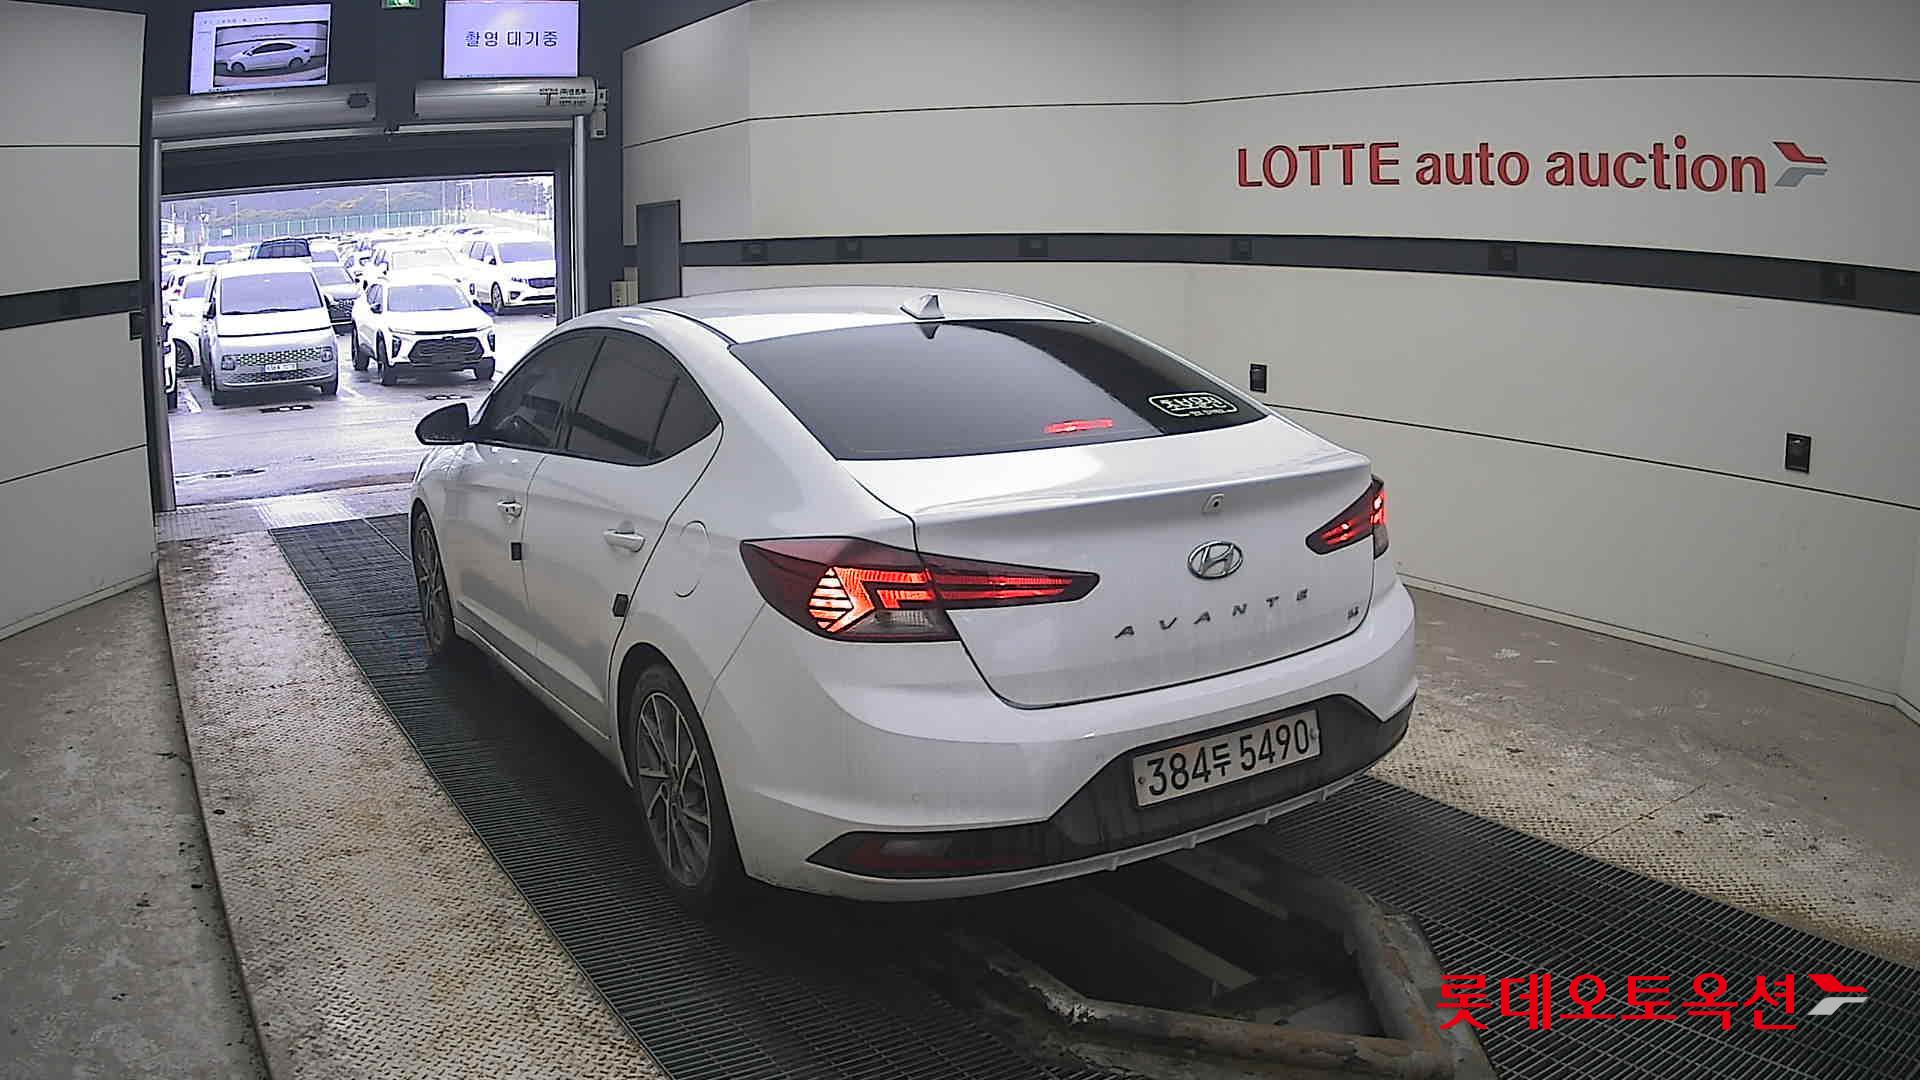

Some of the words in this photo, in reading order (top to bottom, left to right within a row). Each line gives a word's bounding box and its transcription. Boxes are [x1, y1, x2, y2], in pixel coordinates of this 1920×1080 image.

[465, 31, 498, 47] 촬영
[506, 31, 558, 47] 대기중
[1237, 141, 1400, 188] LOTTE
[1415, 141, 1530, 187] auto
[1545, 134, 1767, 195] auction
[1114, 588, 1309, 639] AVANTE
[1147, 742, 1231, 796] 384두
[1239, 719, 1310, 772] 5490
